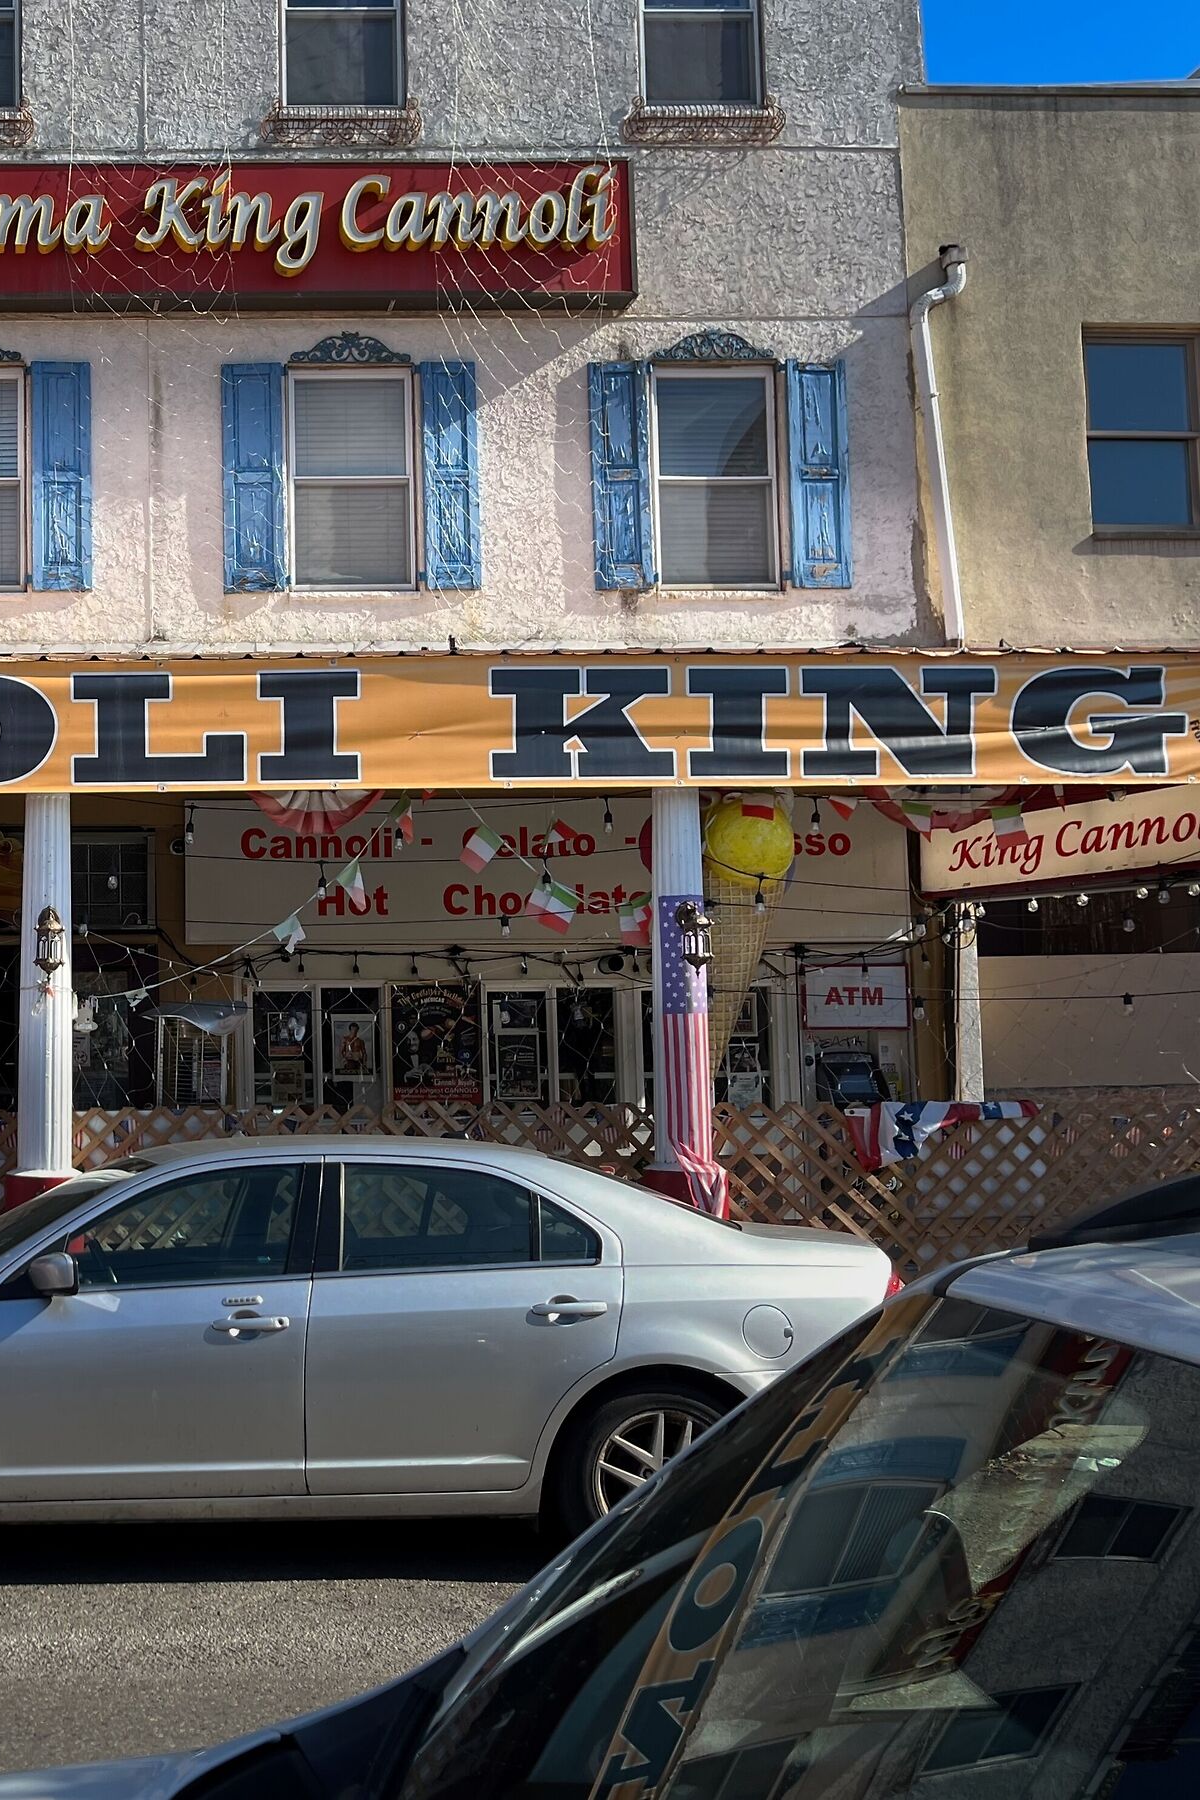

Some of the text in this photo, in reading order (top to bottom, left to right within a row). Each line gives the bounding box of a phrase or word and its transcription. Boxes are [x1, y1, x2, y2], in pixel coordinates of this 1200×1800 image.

[134, 168, 325, 278] King
[339, 164, 618, 252] Cannoli
[489, 665, 1189, 782] KING
[241, 827, 392, 859] Cannoli
[948, 812, 1200, 875] King Canno
[318, 885, 388, 916] Hot
[825, 986, 883, 1006] ATM
